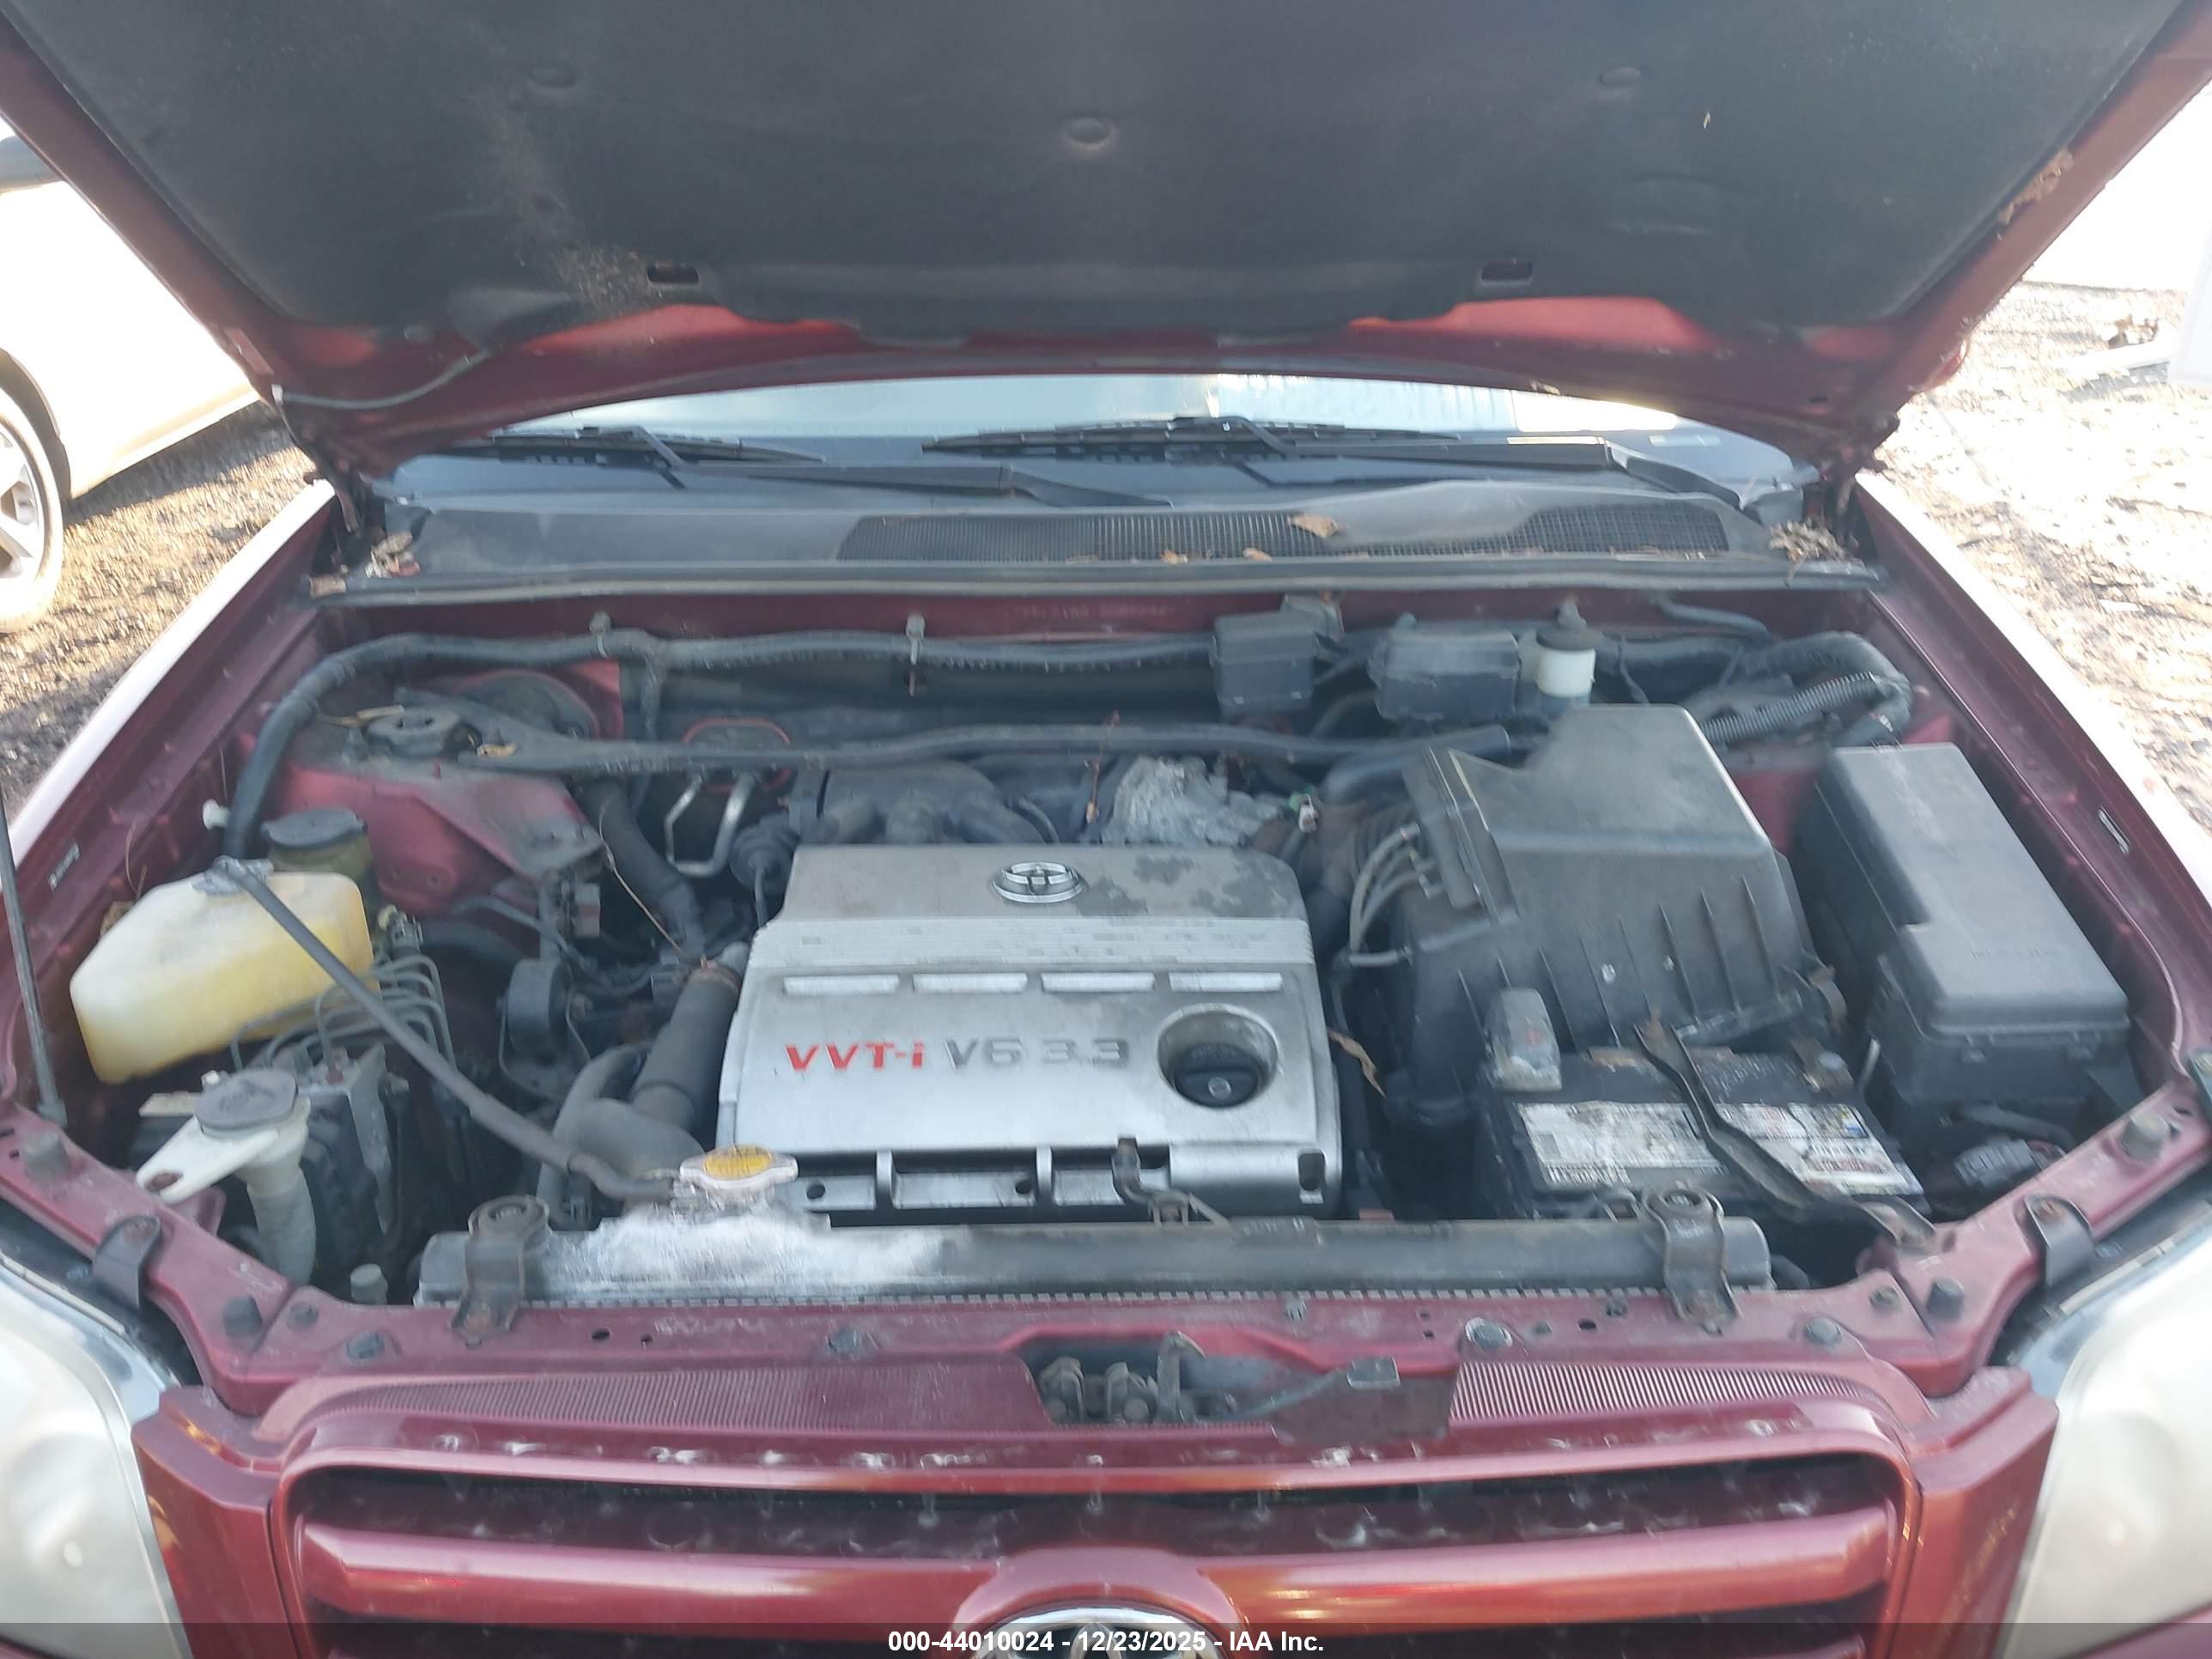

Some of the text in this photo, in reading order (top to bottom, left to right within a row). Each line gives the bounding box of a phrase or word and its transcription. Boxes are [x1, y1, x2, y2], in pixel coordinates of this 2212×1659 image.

[784, 1036, 1131, 1071] VVT-i V6 3.3
